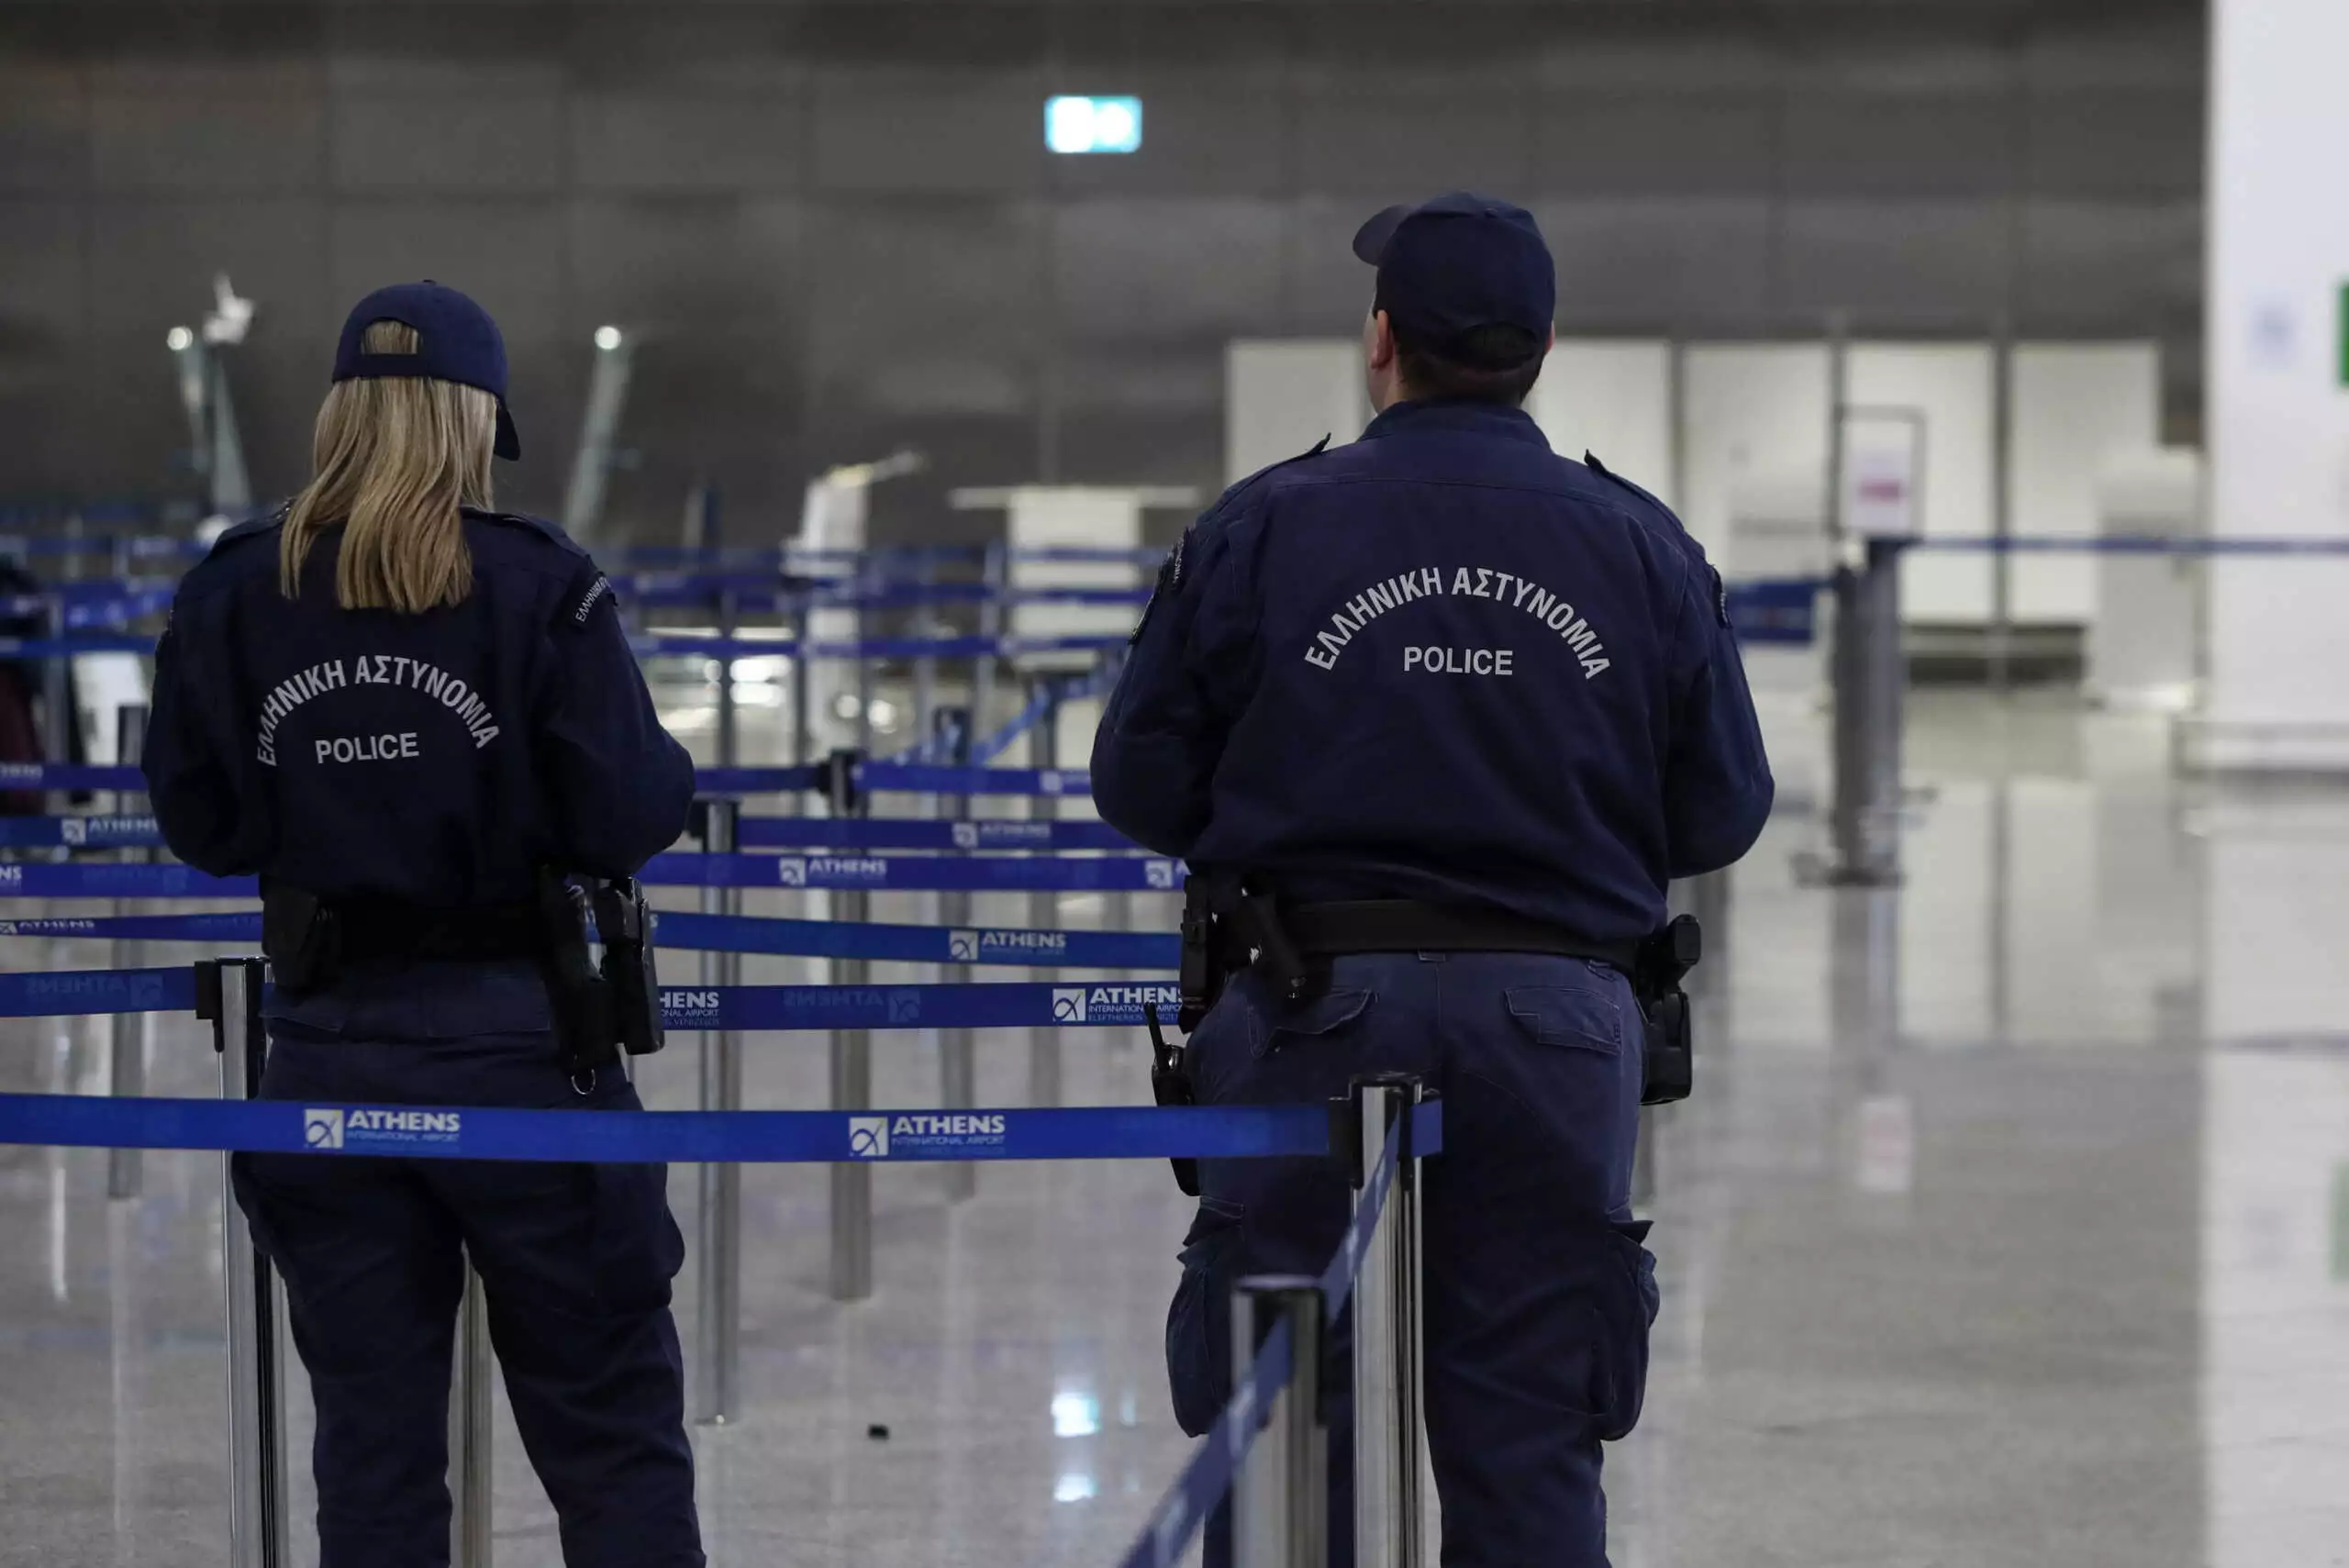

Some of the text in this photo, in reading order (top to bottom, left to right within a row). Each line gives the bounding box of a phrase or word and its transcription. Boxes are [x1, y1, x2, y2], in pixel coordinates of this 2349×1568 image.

[1305, 567, 1610, 679] ΕΛΛΗΝΙΚΗ ΑΣΤΥΝΟΜΙΑ
[1404, 646, 1513, 675] POLICE
[257, 654, 500, 767] ΕΛΛΗΝΙΚΗ ΑΣΤΥΝΟΜΙΑ
[315, 732, 419, 764] POLICE
[808, 858, 887, 875] ATHENS
[982, 930, 1066, 949] ATHENS
[660, 991, 720, 1008] HENS
[1088, 1005, 1144, 1013] INTERNATION
[347, 1109, 461, 1133] ATHENS
[892, 1115, 1006, 1135] ATHENS
